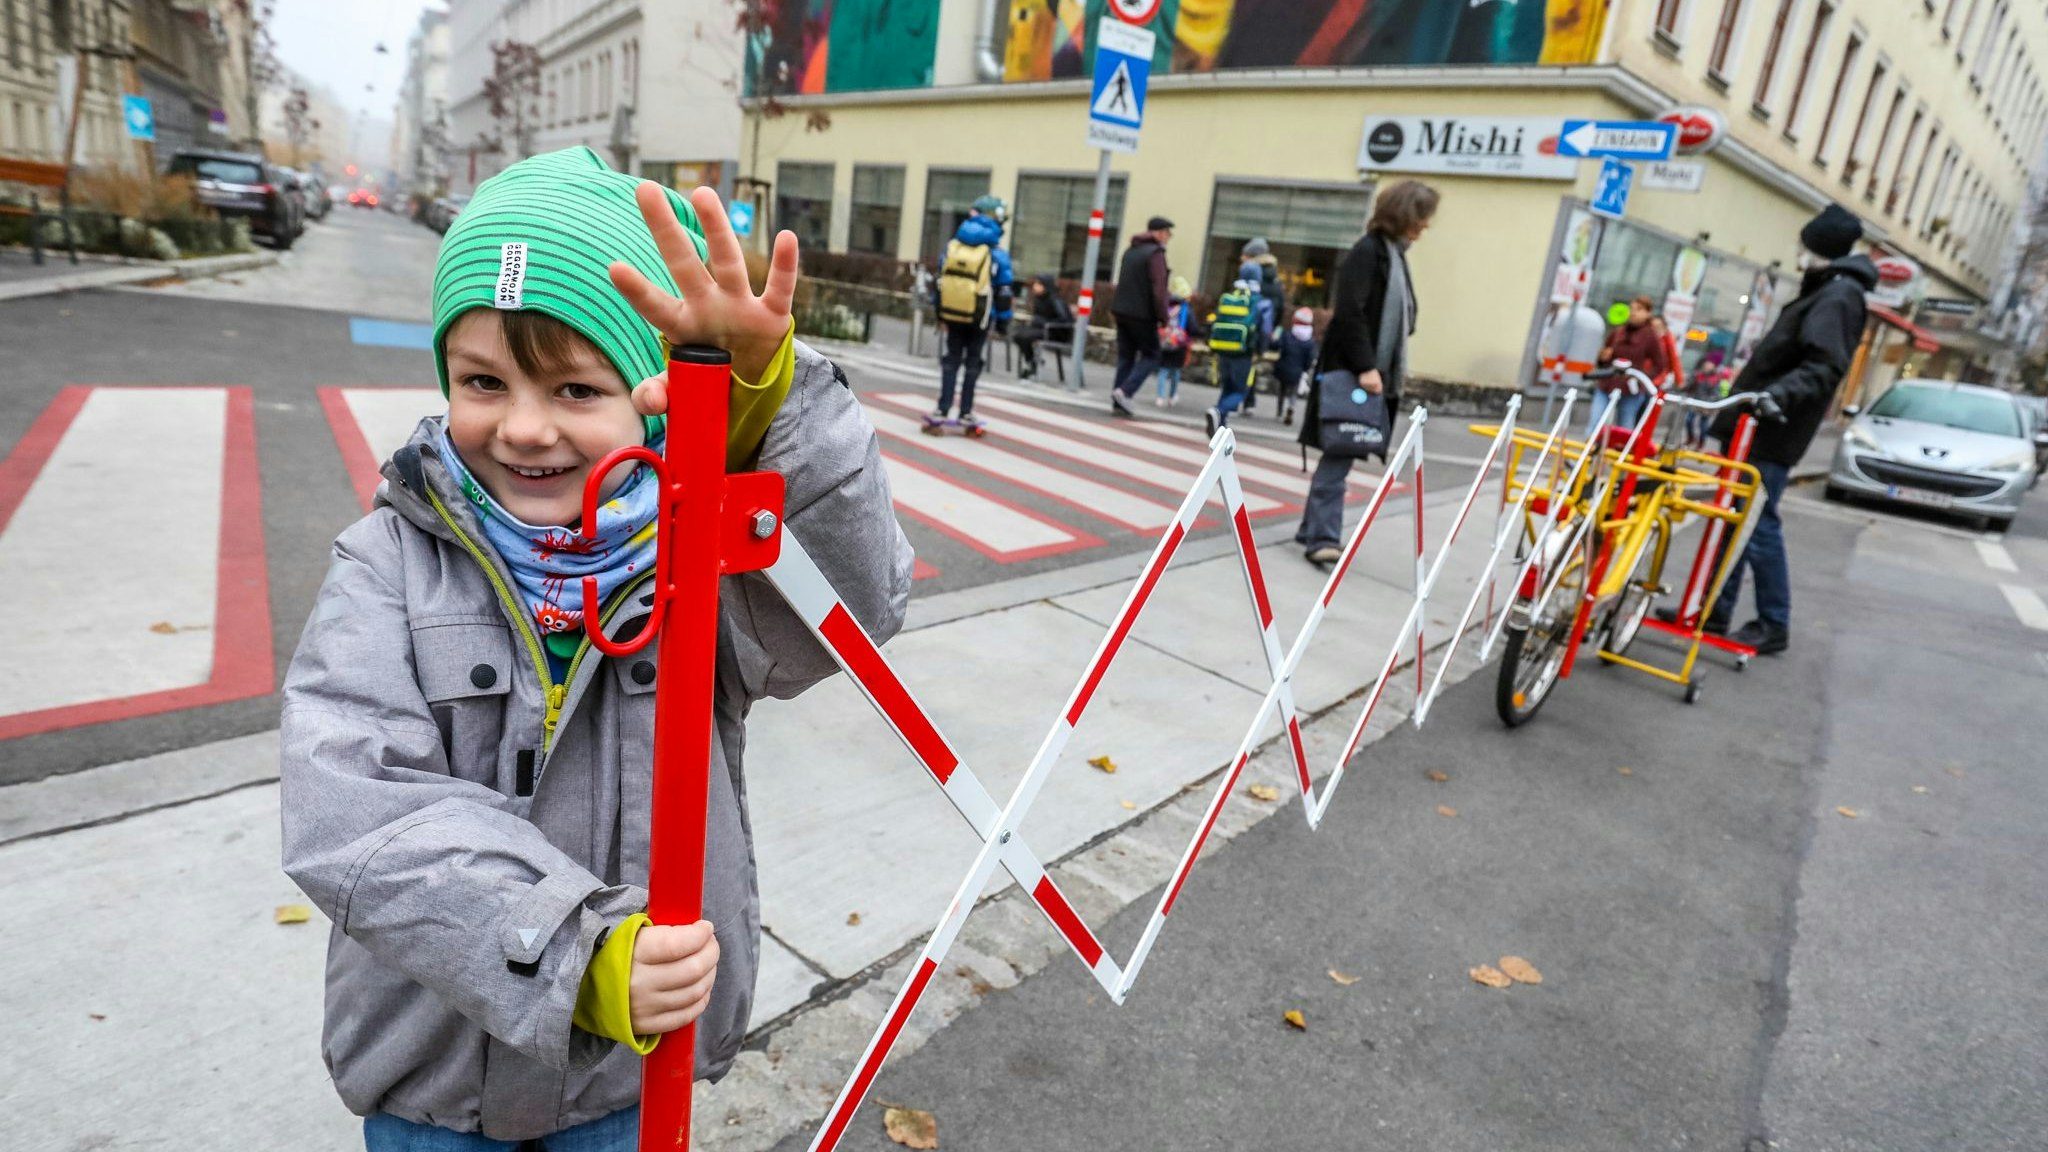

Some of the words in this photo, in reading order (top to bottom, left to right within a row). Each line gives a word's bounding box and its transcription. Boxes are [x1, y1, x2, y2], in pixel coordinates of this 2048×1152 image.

[1414, 119, 1525, 156] Mishi
[1594, 129, 1659, 148] EINBAHN
[500, 244, 513, 301] COLLECTION
